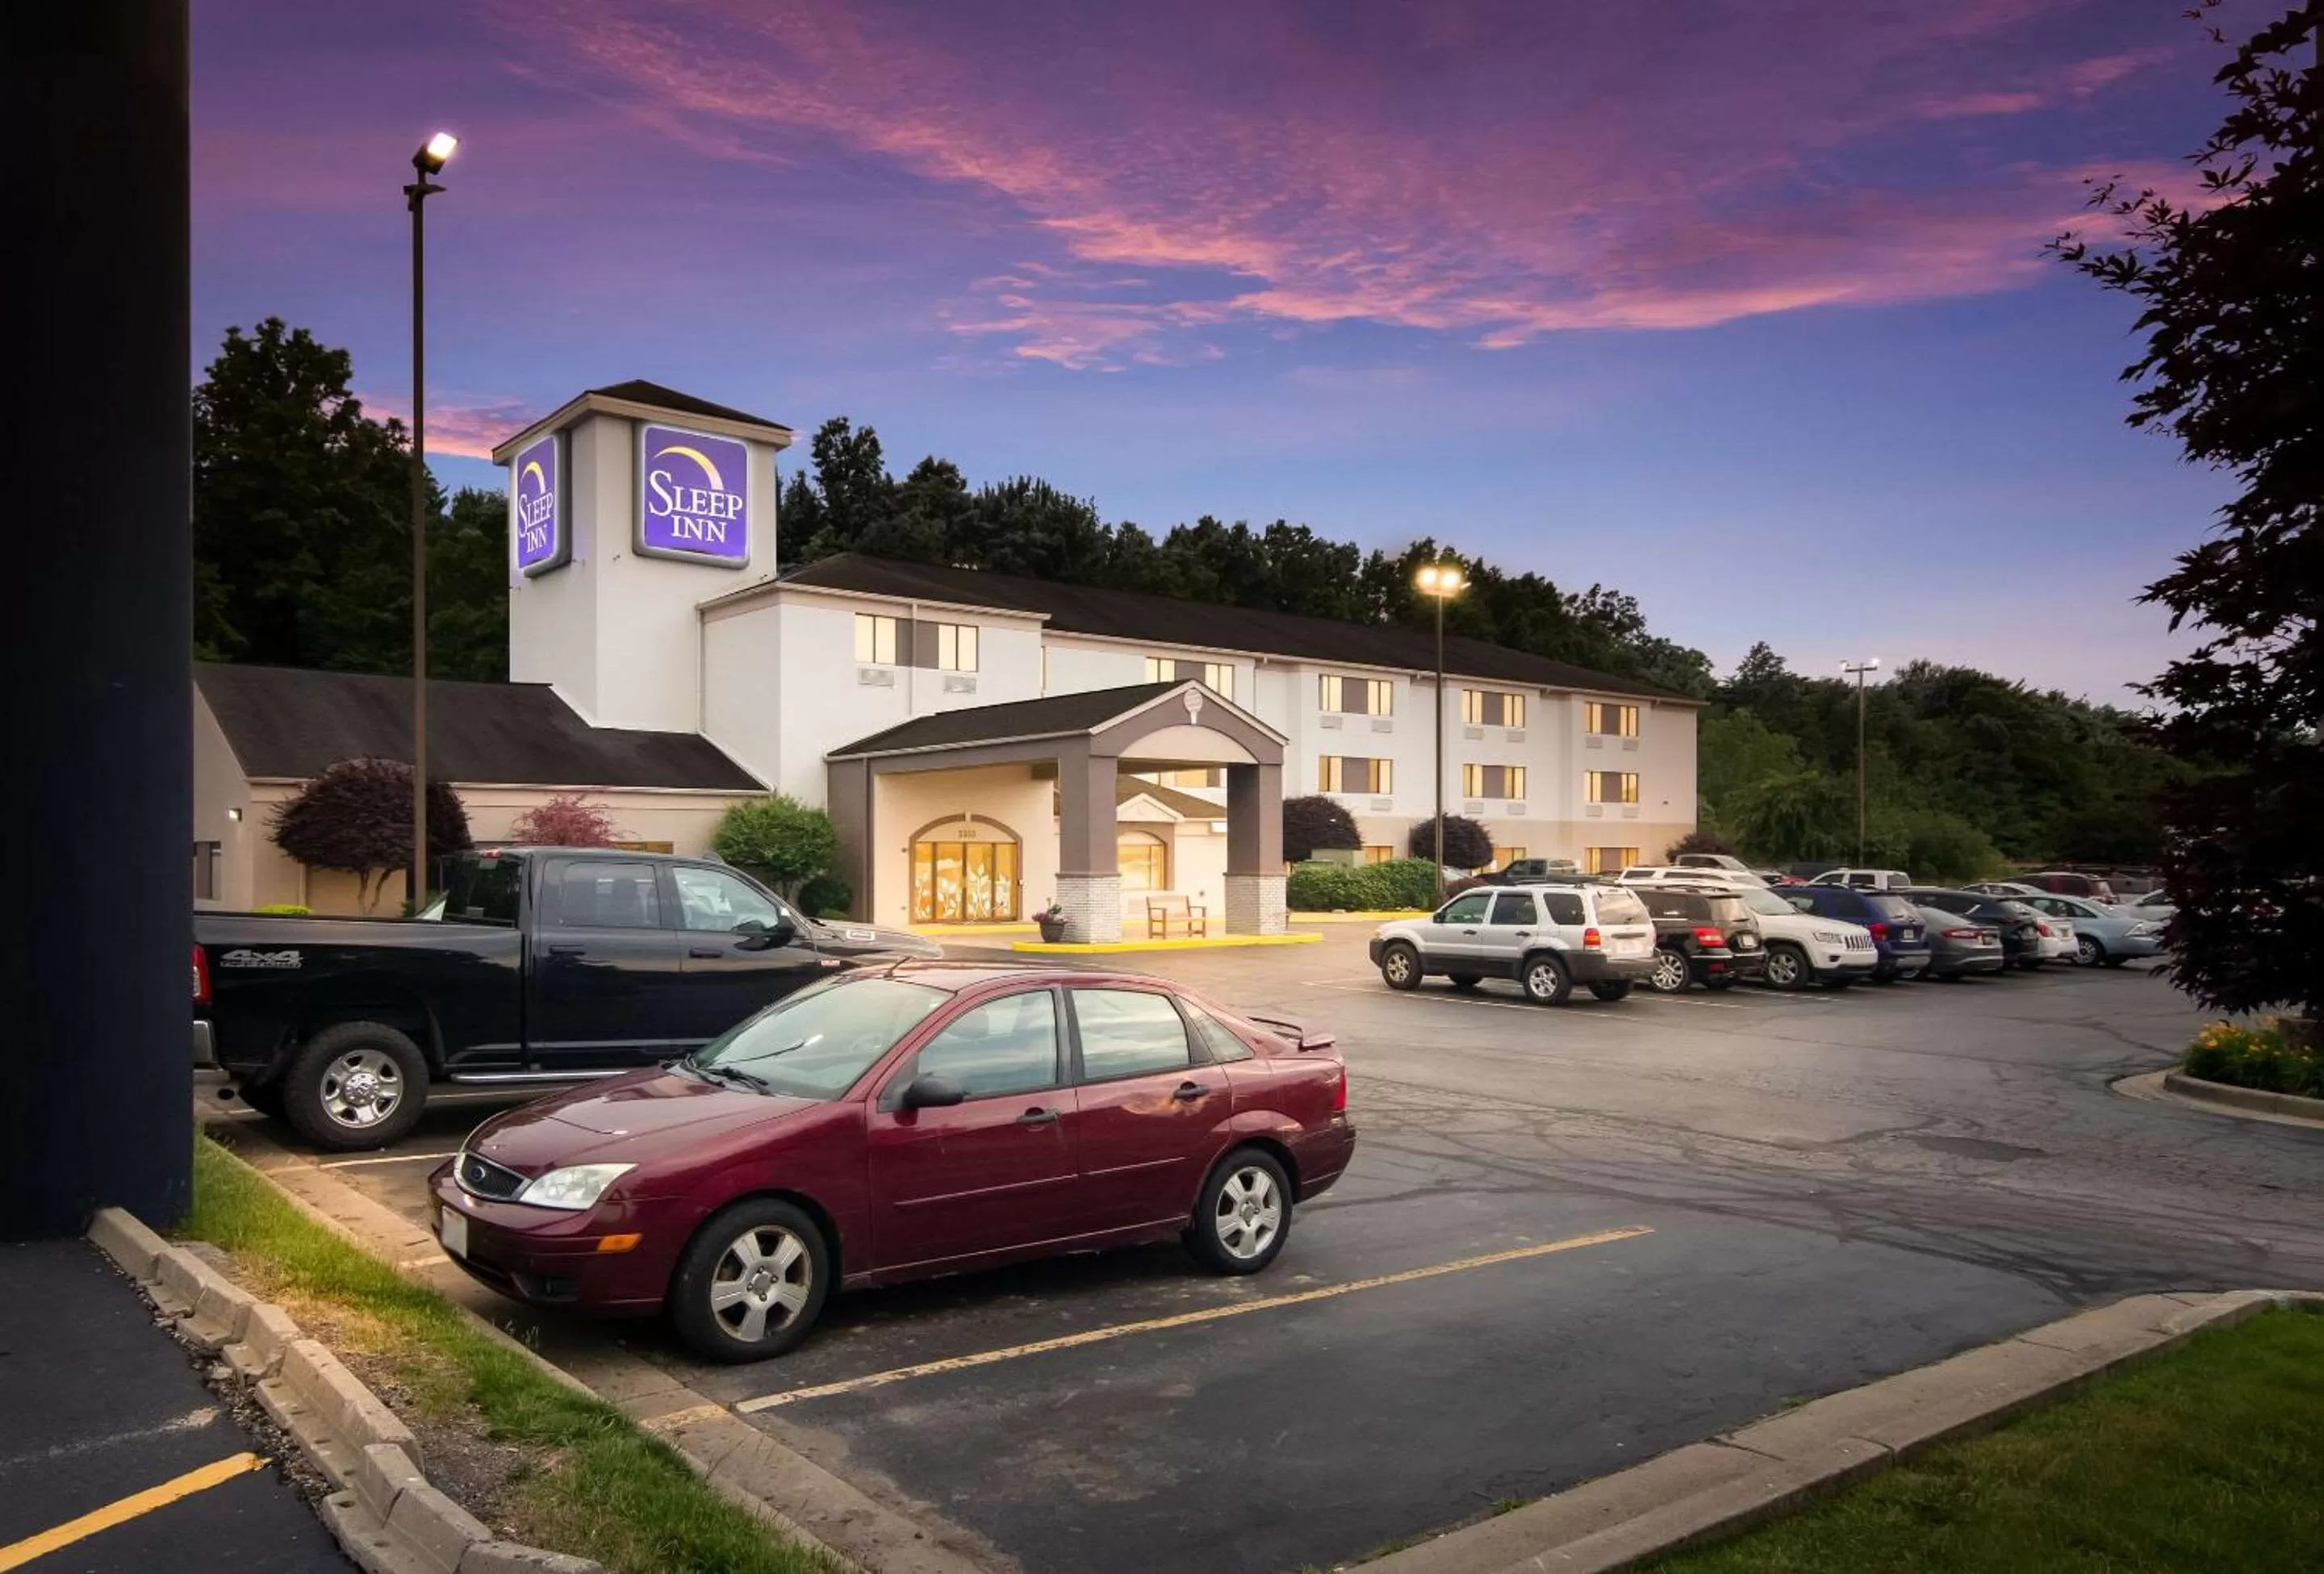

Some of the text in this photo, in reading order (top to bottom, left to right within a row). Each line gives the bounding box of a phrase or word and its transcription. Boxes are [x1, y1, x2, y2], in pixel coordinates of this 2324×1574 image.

[649, 470, 743, 520] SLEEP
[519, 492, 554, 538] SLEEP
[671, 515, 726, 543] INN
[526, 524, 549, 553] INN
